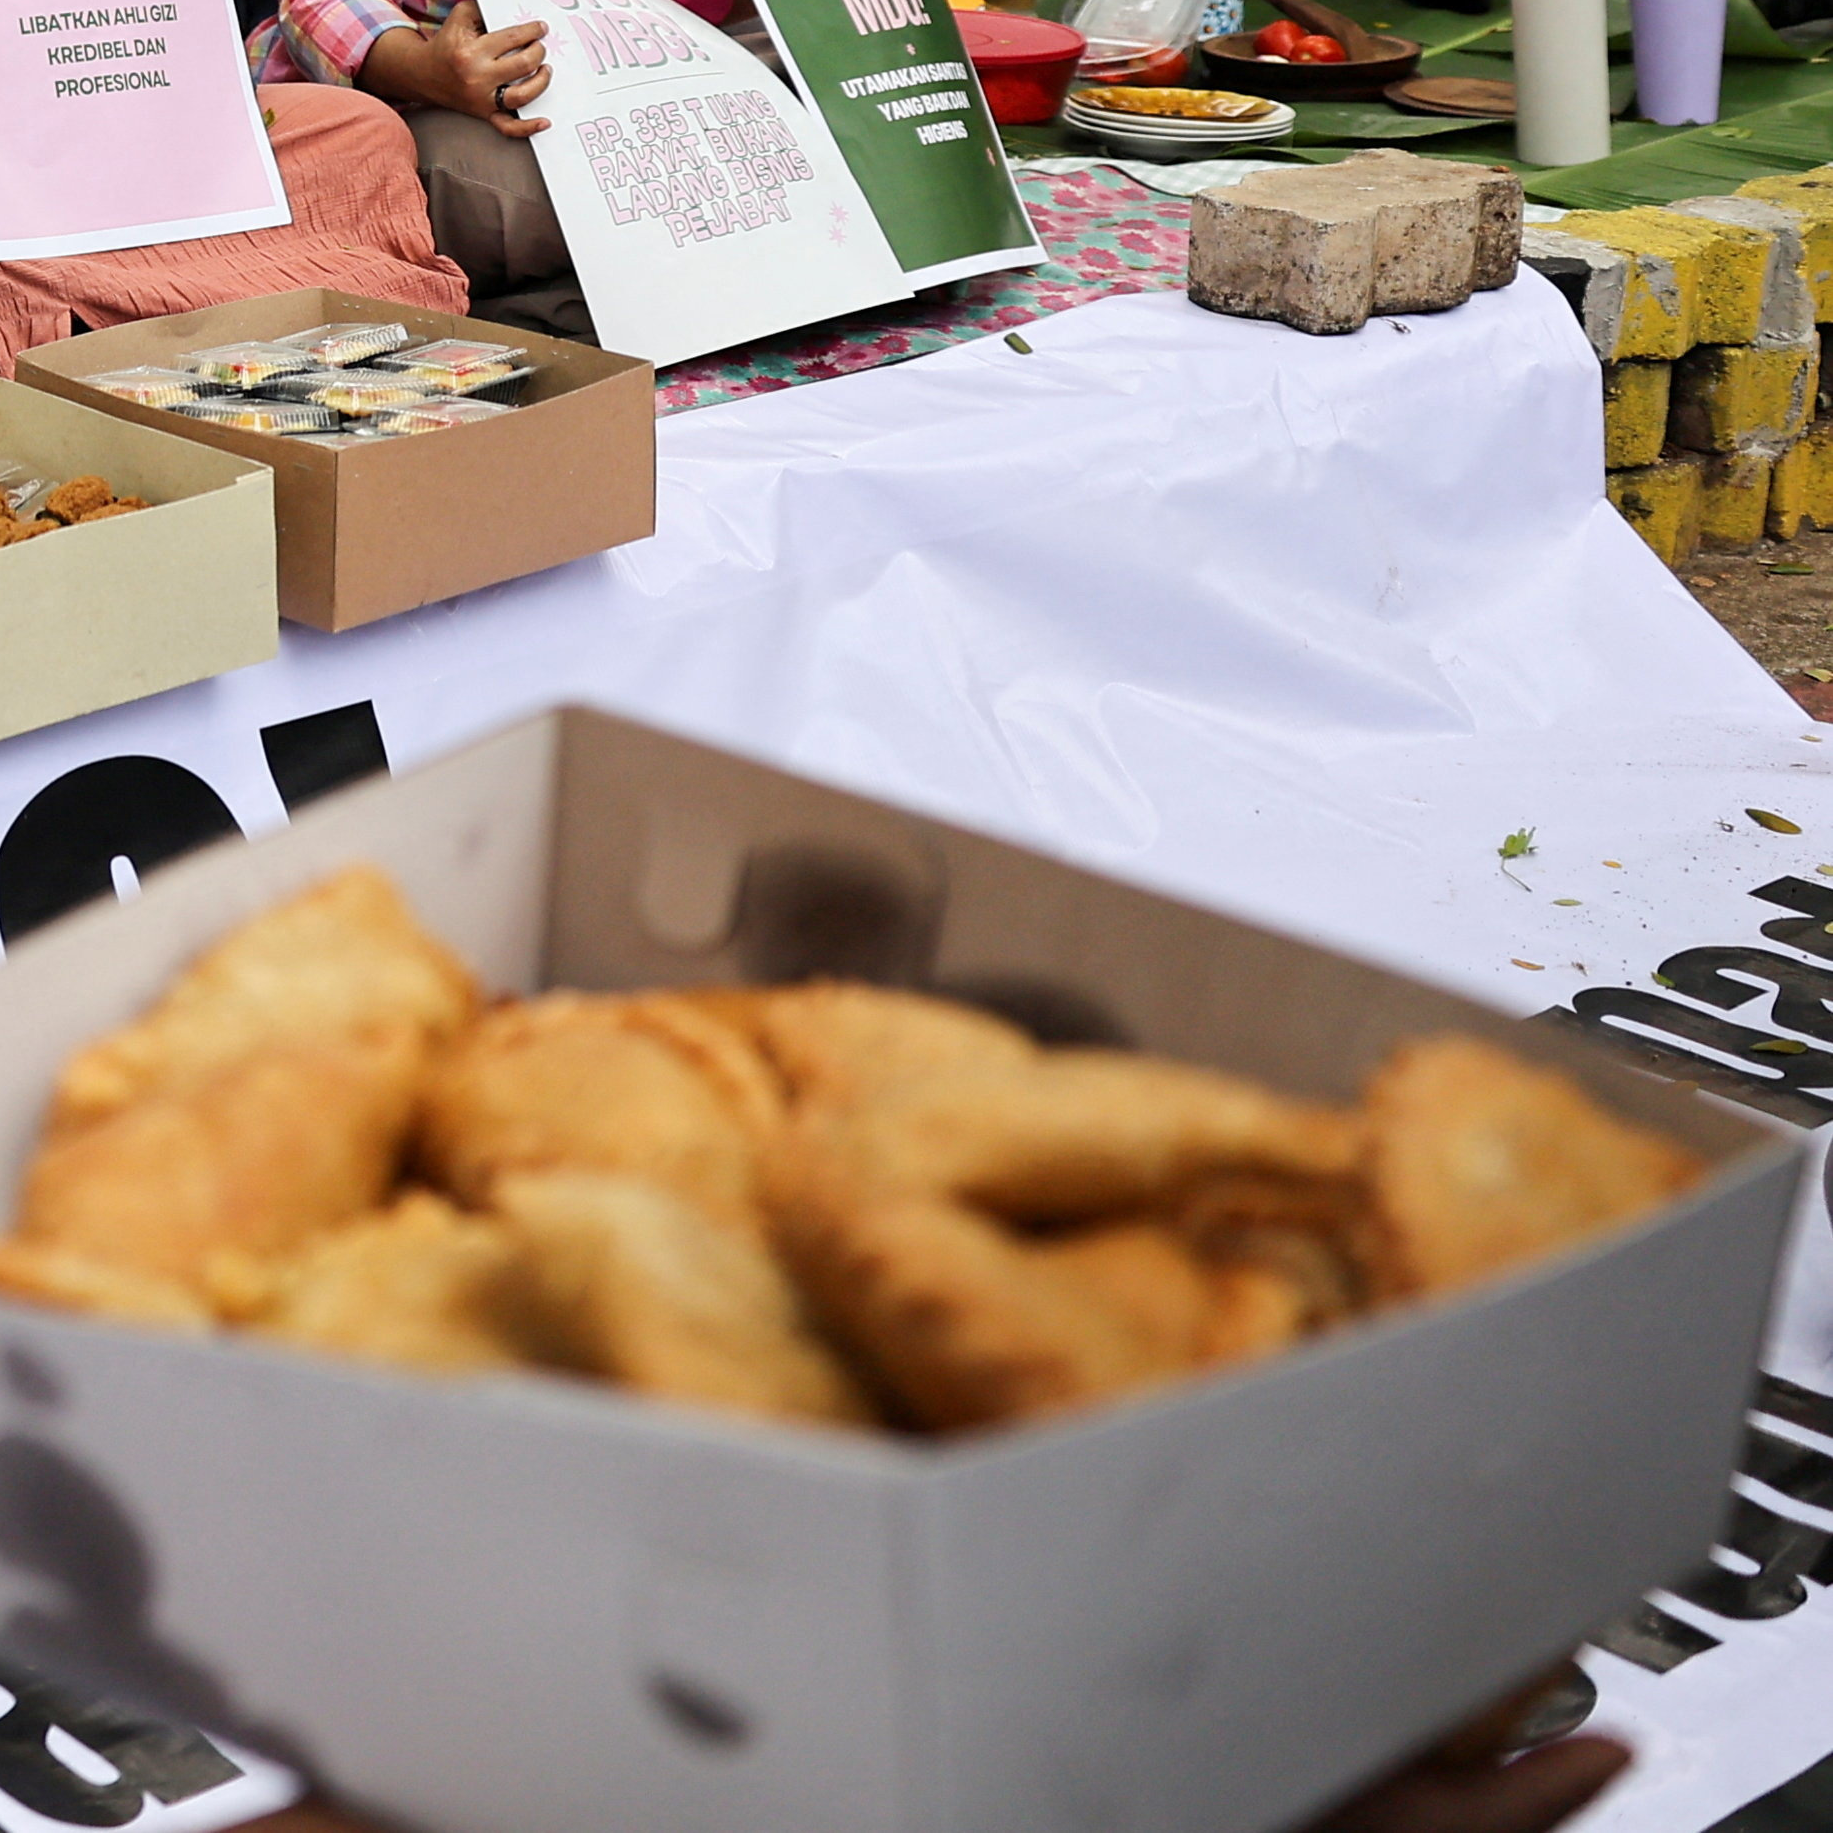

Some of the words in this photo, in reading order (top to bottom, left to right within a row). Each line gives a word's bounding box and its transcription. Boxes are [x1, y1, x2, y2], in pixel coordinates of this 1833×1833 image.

[19, 9, 111, 35] LIBATKAN
[113, 6, 149, 26] AHLI
[149, 4, 178, 23] GIZI
[568, 9, 711, 75] MBG!
[47, 40, 133, 66] KREDIBEL
[133, 37, 167, 57] DAN
[54, 69, 171, 98] PROFESIONAL
[840, 65, 932, 99] UTAMAKAN
[575, 116, 634, 157] RP.
[629, 101, 689, 144] 335
[682, 98, 709, 132] T
[705, 90, 777, 126] UANG
[877, 96, 926, 122] YANG
[589, 133, 711, 192] RAKYAT,
[705, 118, 798, 163] BUKAN
[605, 166, 730, 225] LADANG
[727, 148, 815, 195] BISNIS
[663, 187, 792, 248] PEJABAT
